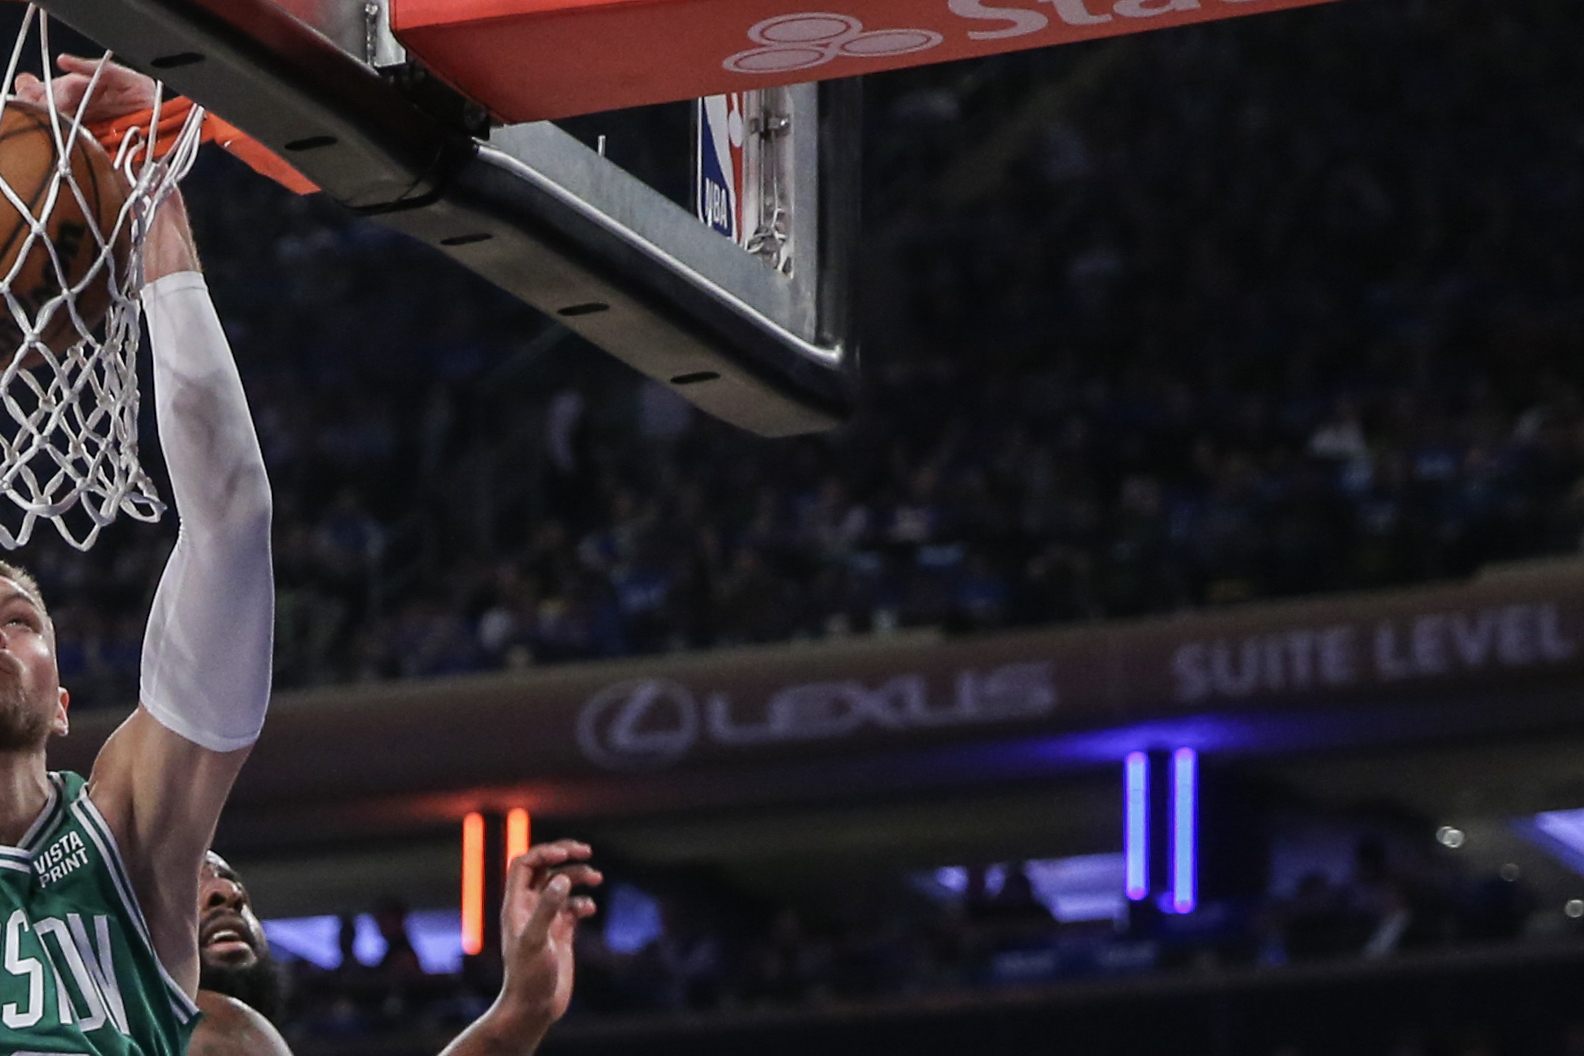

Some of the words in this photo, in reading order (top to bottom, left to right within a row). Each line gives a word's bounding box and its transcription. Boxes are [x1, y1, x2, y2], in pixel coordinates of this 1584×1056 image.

[705, 177, 728, 230] NBA
[1173, 627, 1354, 700] SUITE
[1373, 603, 1574, 680] LEVEL
[708, 660, 1057, 743] LEXUS
[33, 831, 84, 875] VISTA
[39, 847, 88, 889] PRINT
